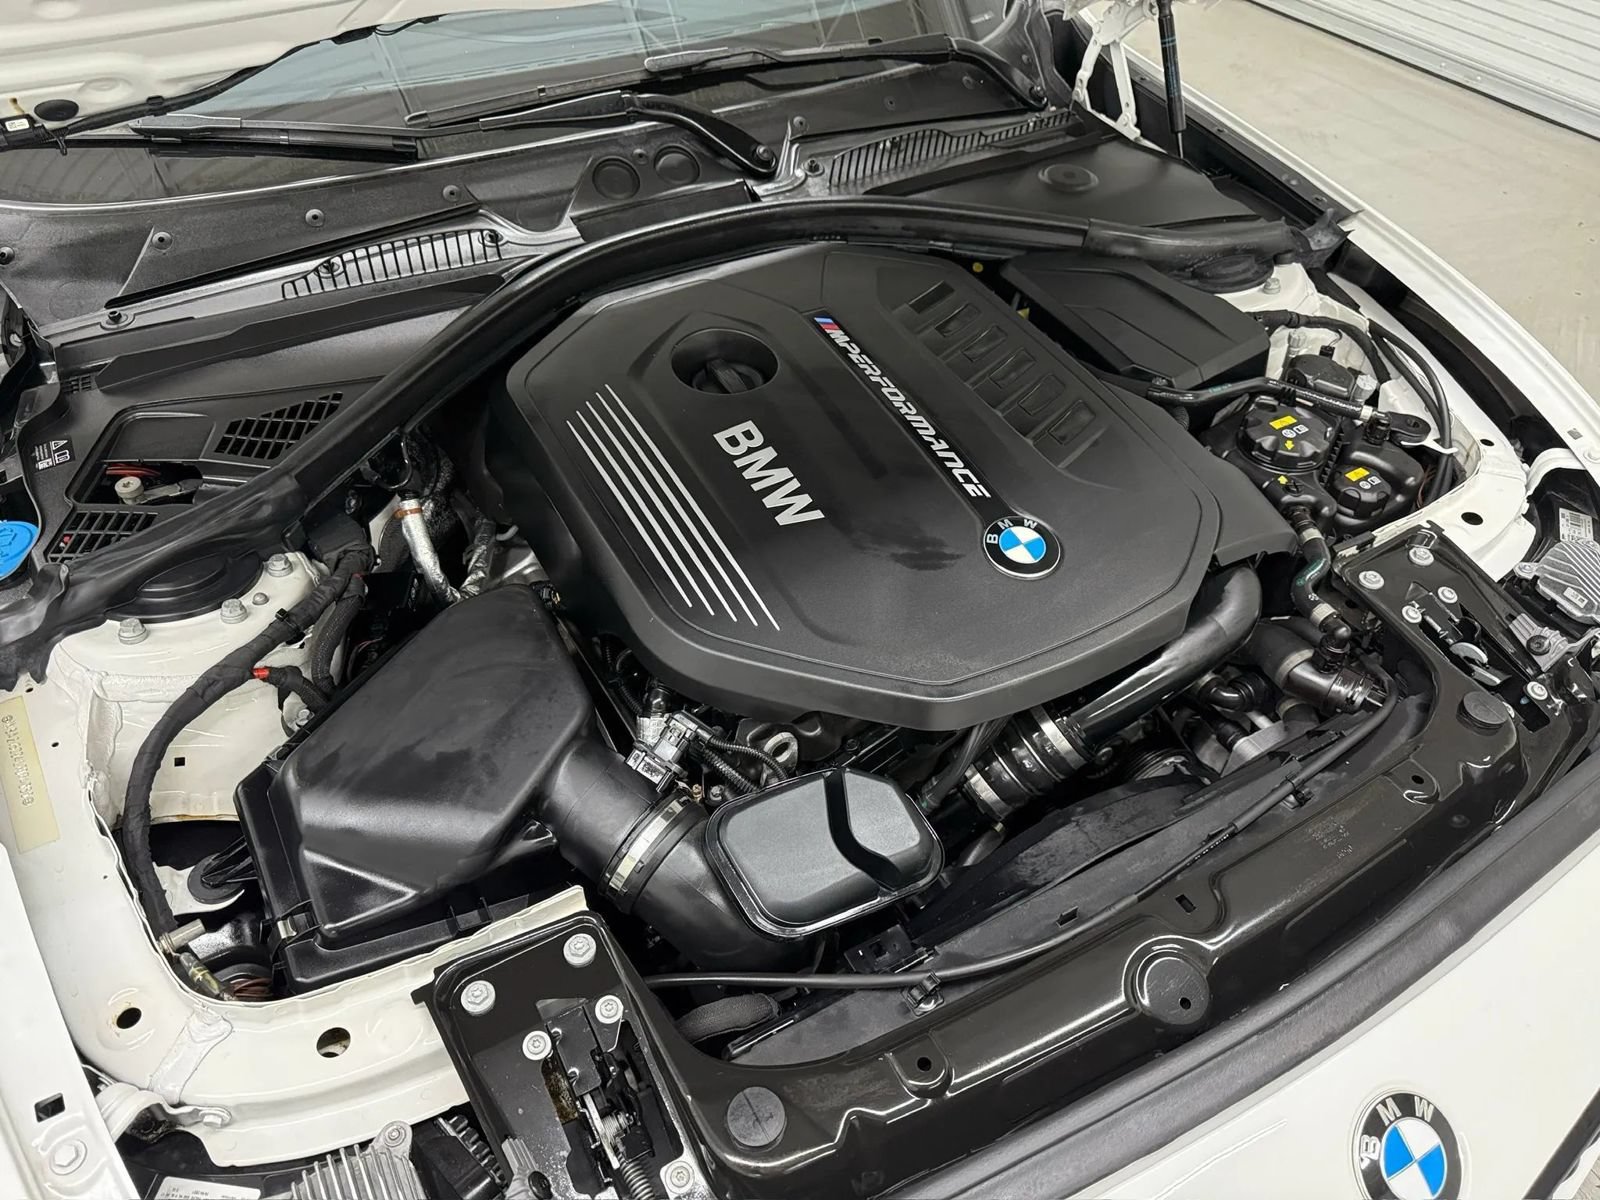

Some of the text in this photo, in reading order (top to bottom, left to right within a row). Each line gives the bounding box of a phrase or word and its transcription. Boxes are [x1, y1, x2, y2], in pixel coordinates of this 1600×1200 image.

[713, 420, 825, 526] BMW
[986, 519, 1037, 544] BMW
[1360, 1095, 1434, 1166] BMW
